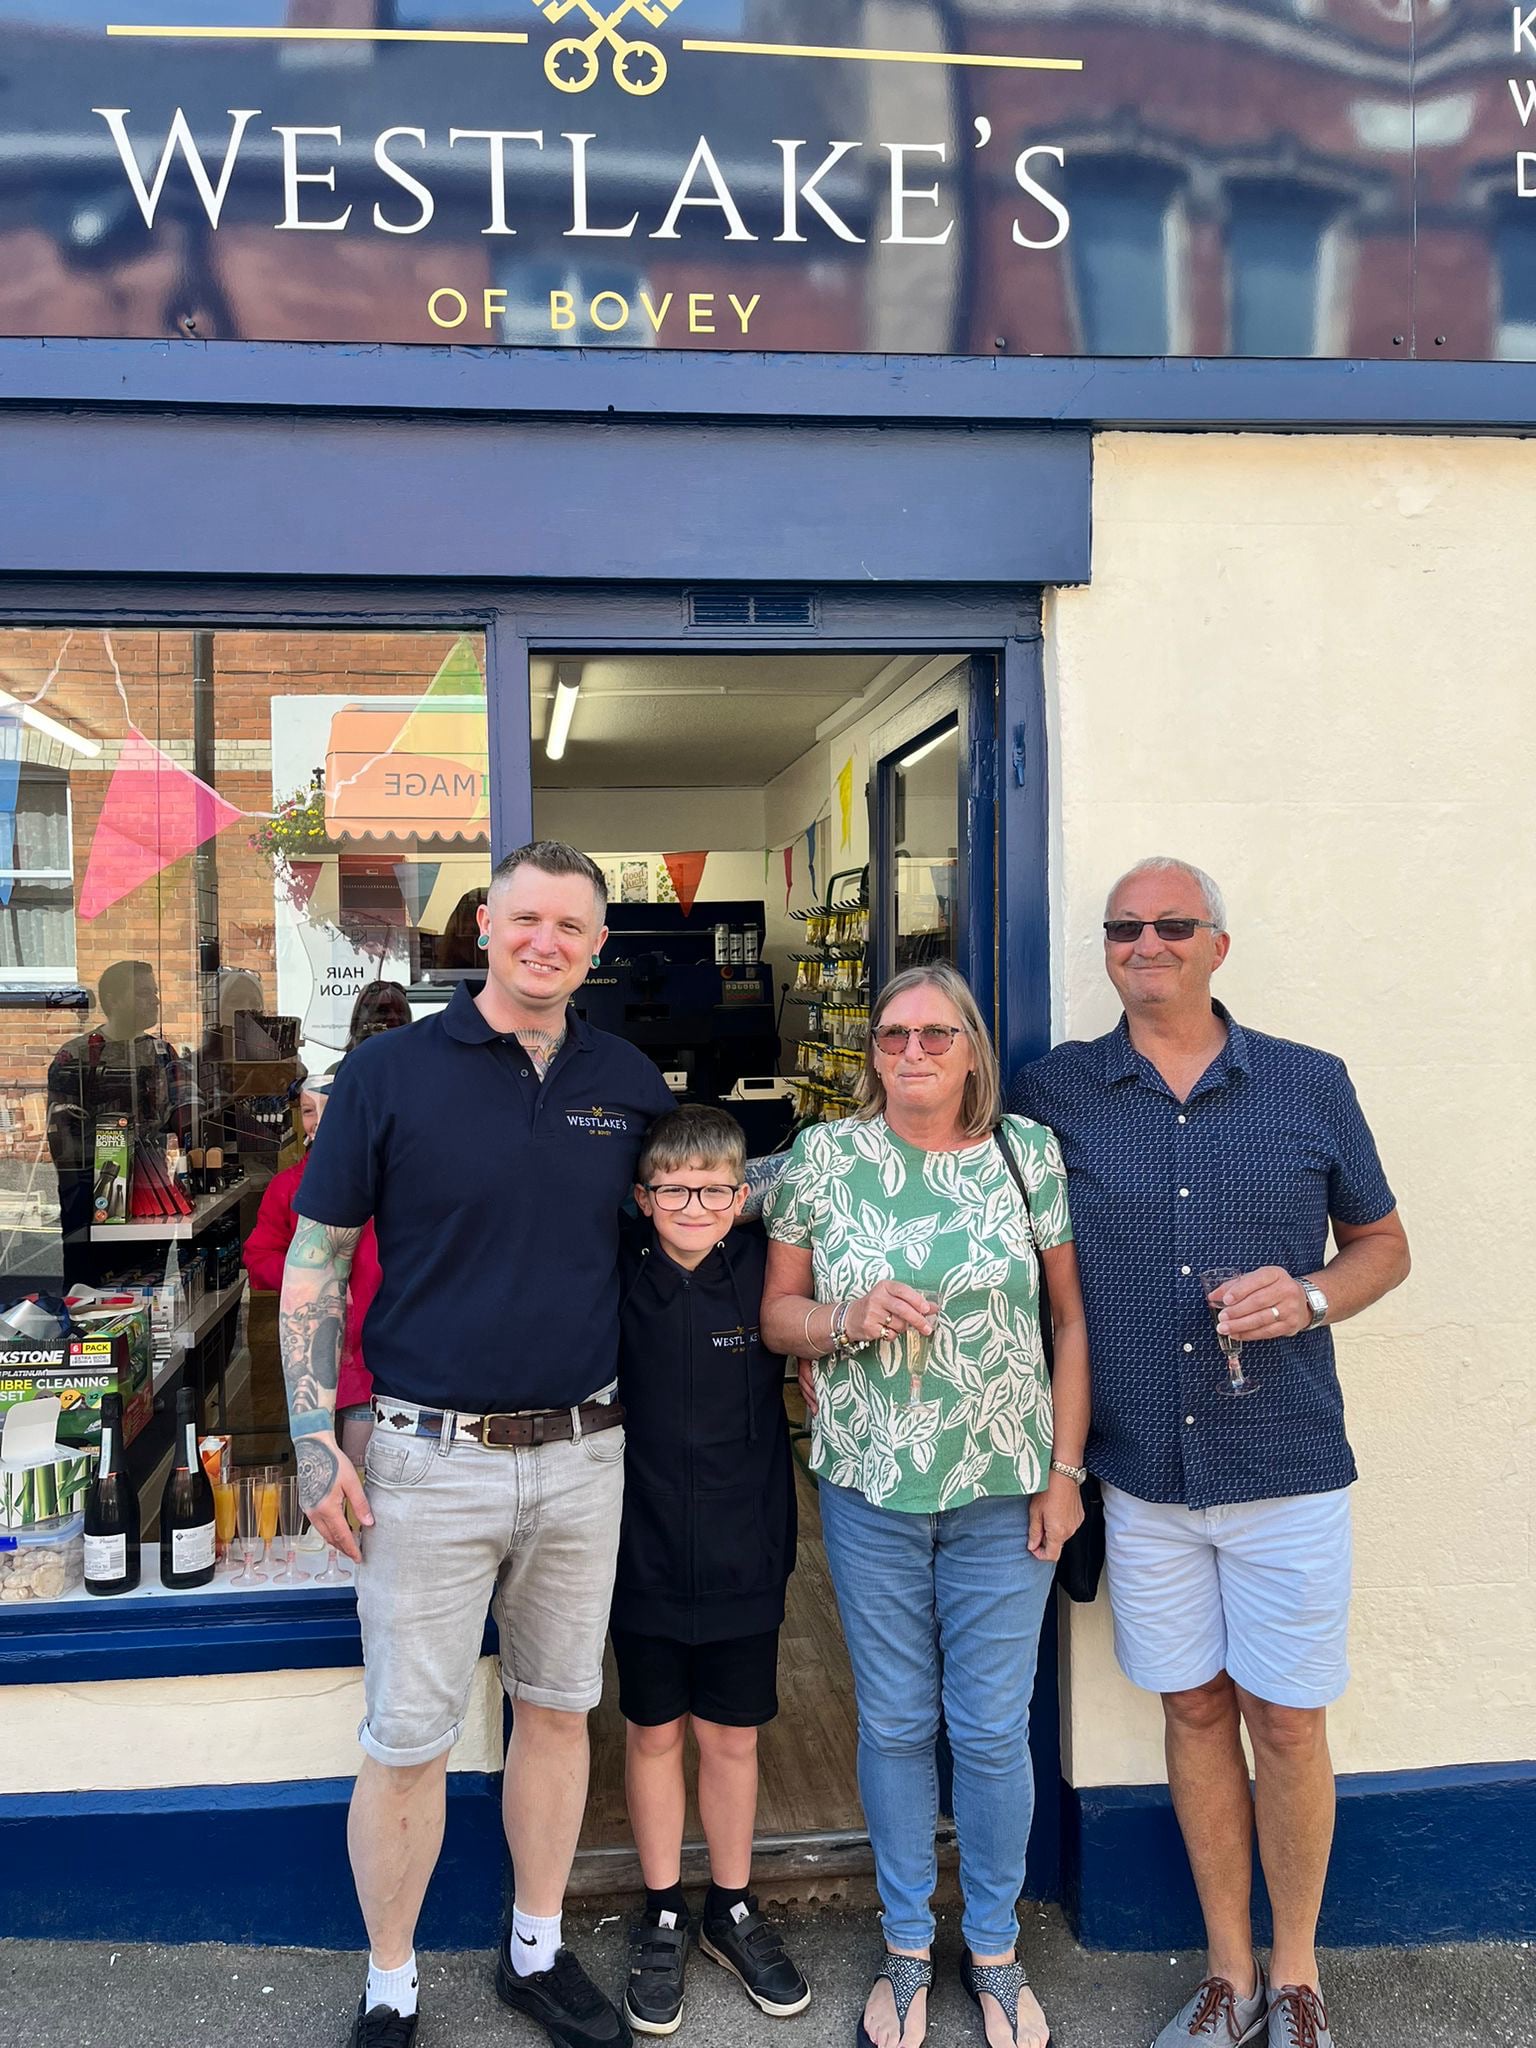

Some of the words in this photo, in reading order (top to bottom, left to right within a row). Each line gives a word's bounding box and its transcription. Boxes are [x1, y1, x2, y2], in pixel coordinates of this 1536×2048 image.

[428, 287, 508, 329] OF
[550, 290, 761, 333] BOVEY
[566, 1115, 628, 1131] WESTLAKE'S
[36, 1377, 109, 1389] CLEANING
[0, 1390, 26, 1402] SET
